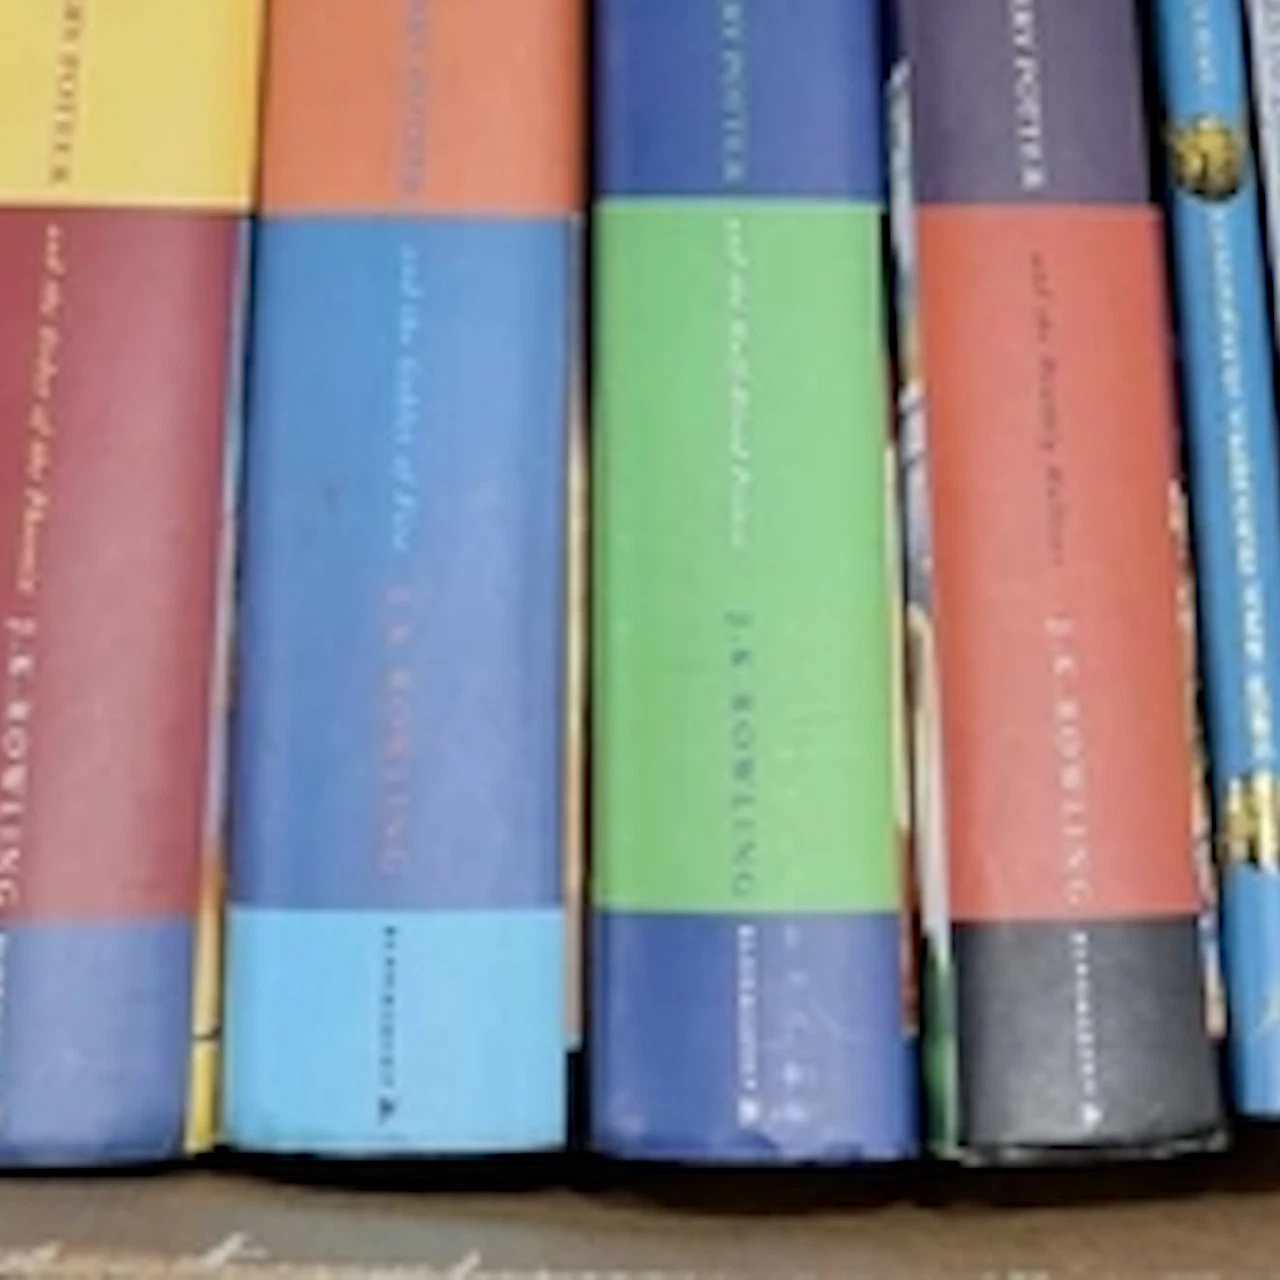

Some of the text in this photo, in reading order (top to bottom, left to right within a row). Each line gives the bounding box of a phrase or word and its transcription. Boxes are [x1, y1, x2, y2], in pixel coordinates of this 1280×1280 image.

[46, 55, 85, 186] POTTER
[716, 51, 746, 181] POTTER
[1008, 57, 1044, 191] POTTER
[42, 225, 71, 276] and
[722, 218, 748, 266] and
[38, 281, 66, 319] the
[32, 325, 64, 398] Order
[25, 439, 54, 480] the
[27, 405, 57, 434] of
[14, 485, 51, 594] Phoenix
[374, 666, 410, 873] ROWLING
[728, 692, 760, 897] ROWLING
[1050, 699, 1093, 908] ROWLING
